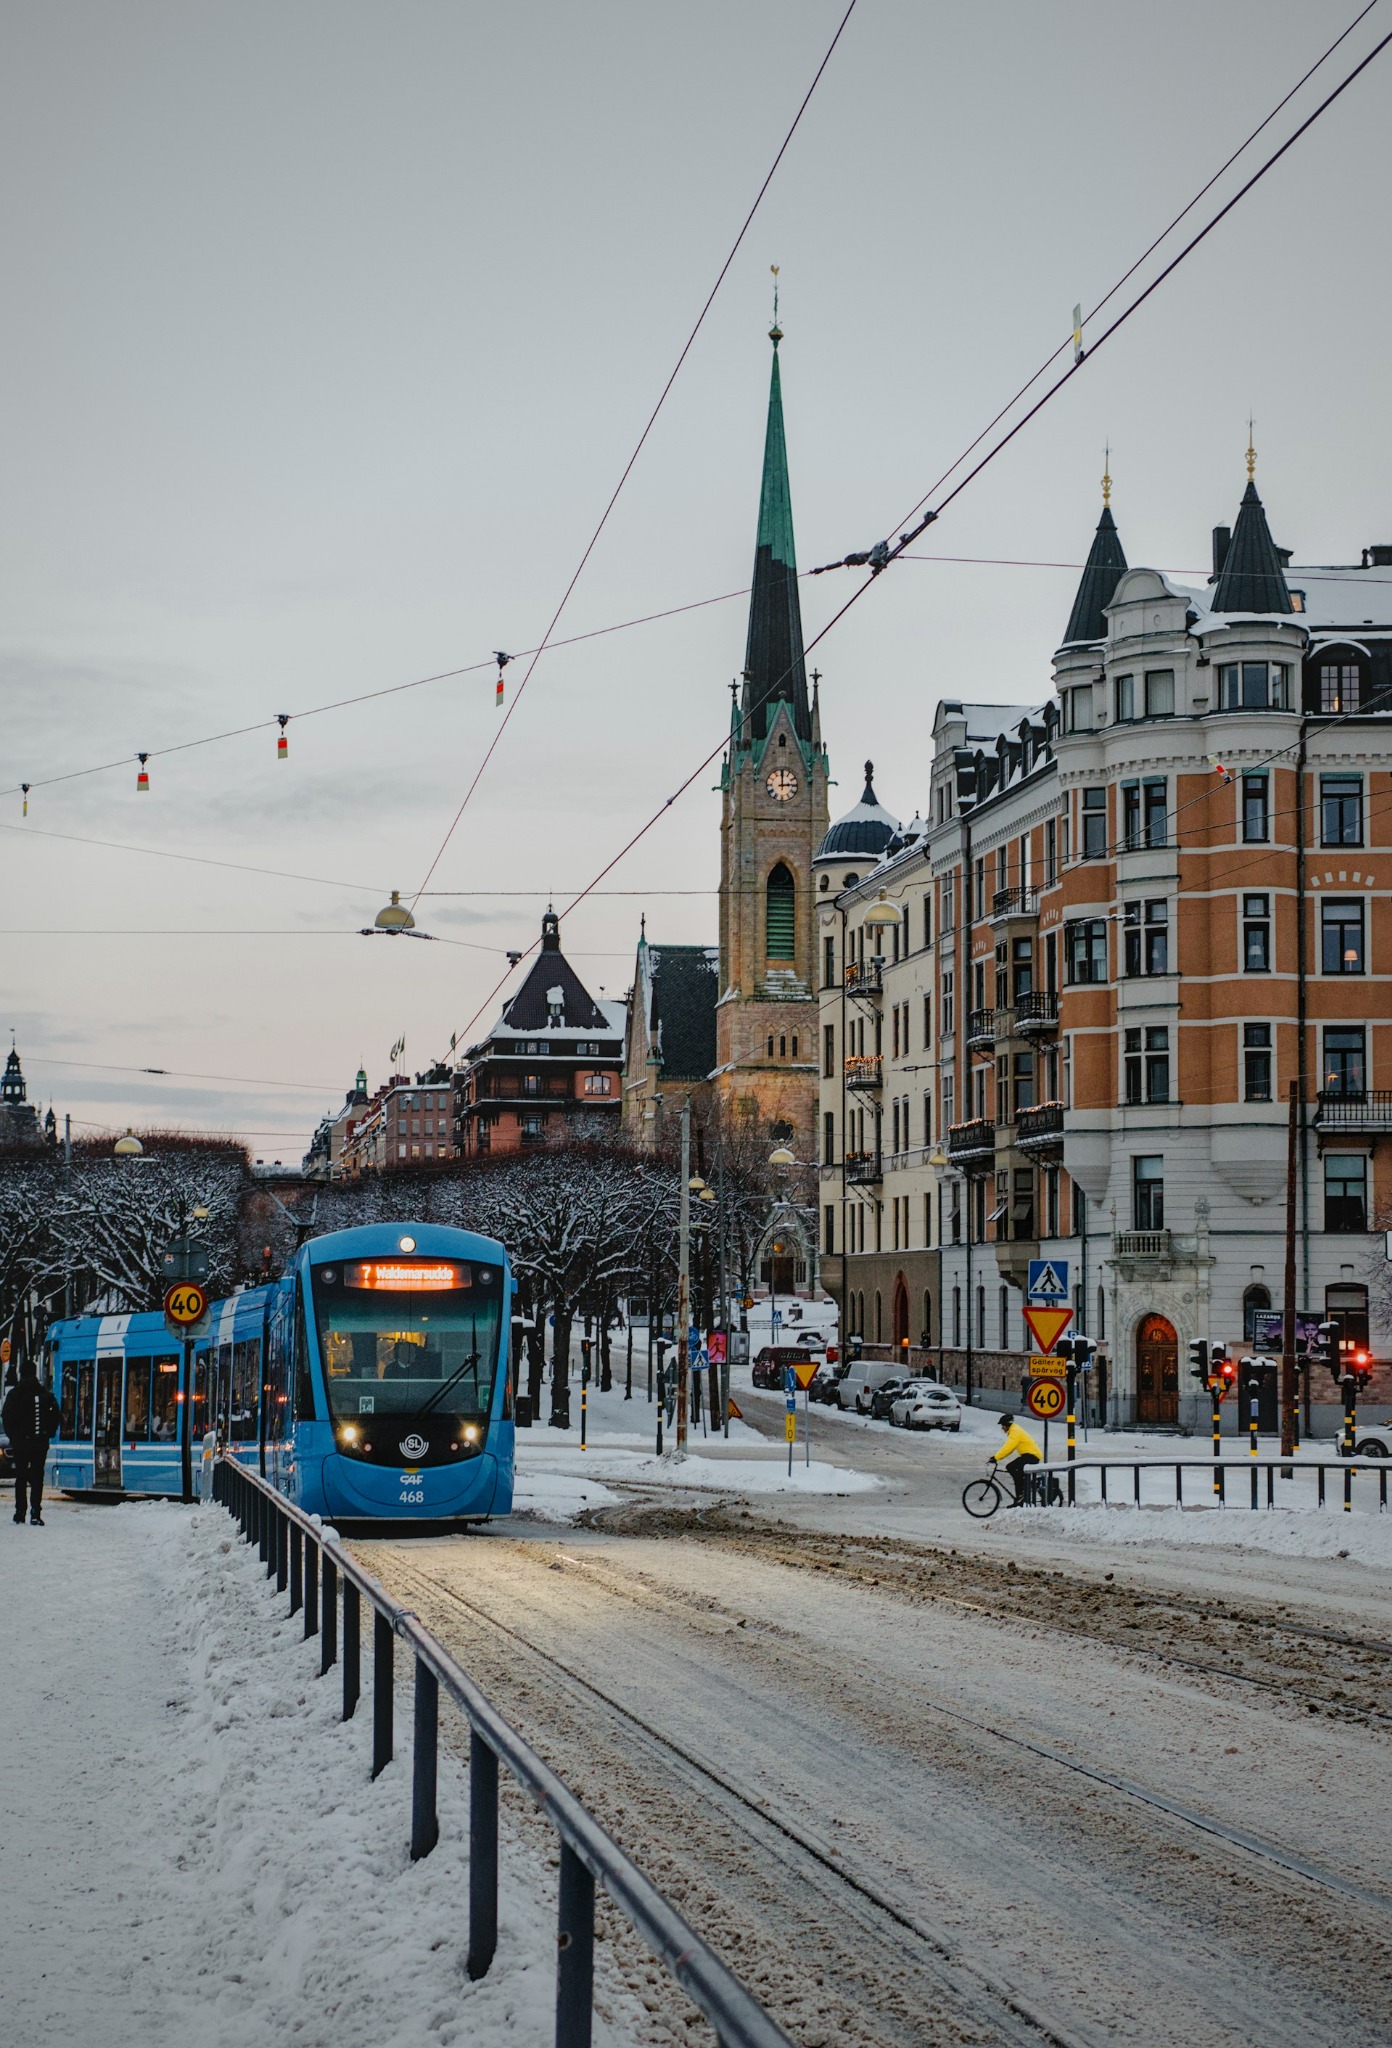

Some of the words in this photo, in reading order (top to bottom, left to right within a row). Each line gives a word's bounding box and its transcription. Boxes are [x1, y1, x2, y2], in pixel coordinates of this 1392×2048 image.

[361, 1265, 371, 1280] 7
[375, 1265, 454, 1280] Waldemarsudde
[171, 1293, 201, 1315] 40
[1031, 1358, 1055, 1366] Gäller
[1056, 1359, 1065, 1367] ej
[1033, 1389, 1060, 1409] 40
[361, 1404, 373, 1412] 14
[407, 1438, 421, 1449] SL
[399, 1475, 424, 1485] CAF
[399, 1491, 424, 1503] 468
